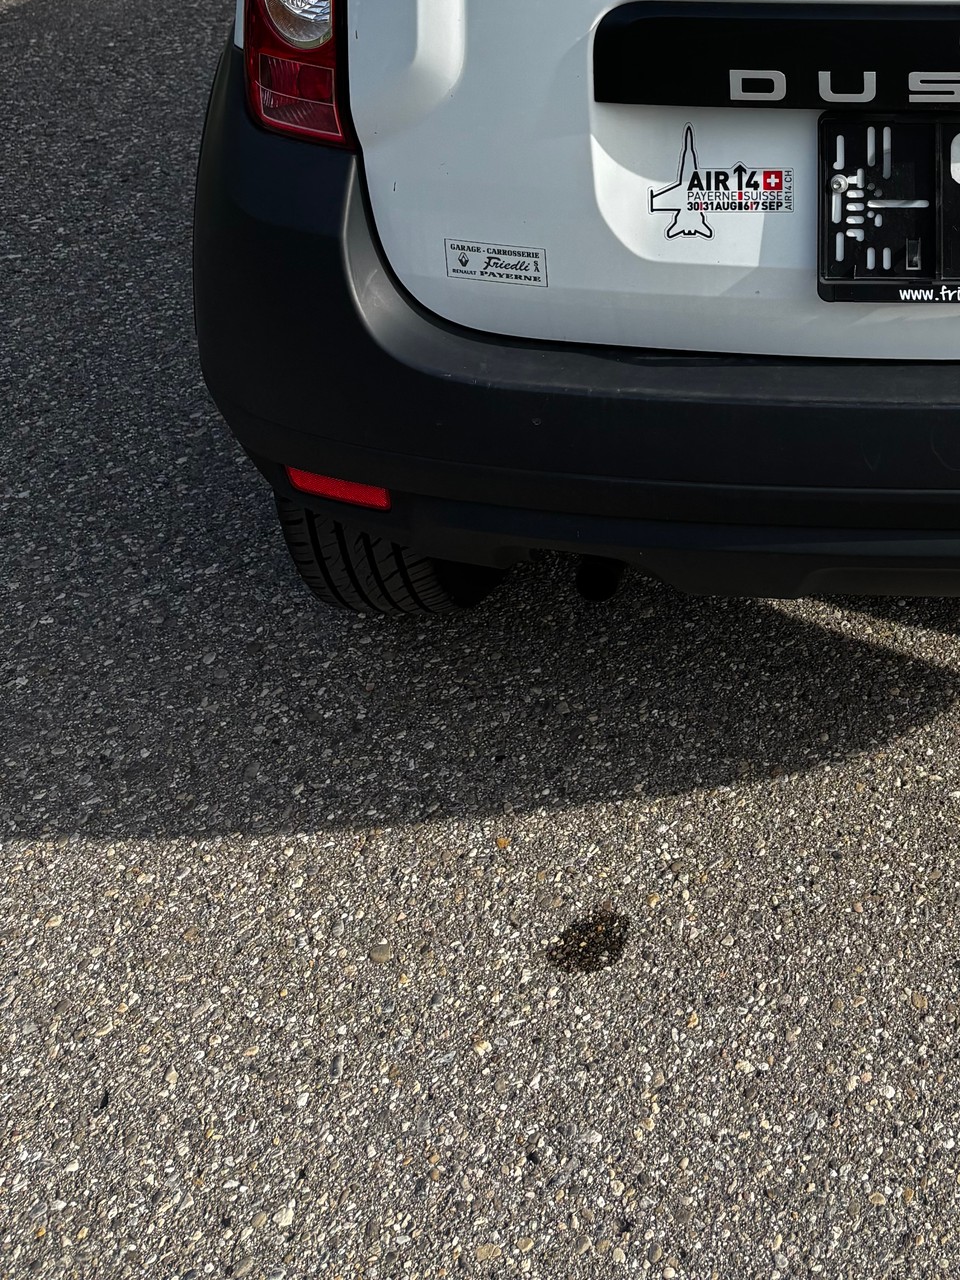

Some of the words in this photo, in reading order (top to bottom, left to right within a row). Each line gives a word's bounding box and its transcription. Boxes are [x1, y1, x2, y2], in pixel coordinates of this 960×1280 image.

[687, 171, 730, 191] AIR
[687, 191, 737, 201] PAYERNE
[743, 191, 783, 201] SUISSE
[784, 170, 792, 210] AIR14.CH
[761, 201, 783, 211] SEP
[450, 243, 481, 254] GARAGE
[486, 247, 540, 259] CARROSSERIE
[483, 256, 530, 272] Friedli
[479, 270, 542, 282] PAYERNE
